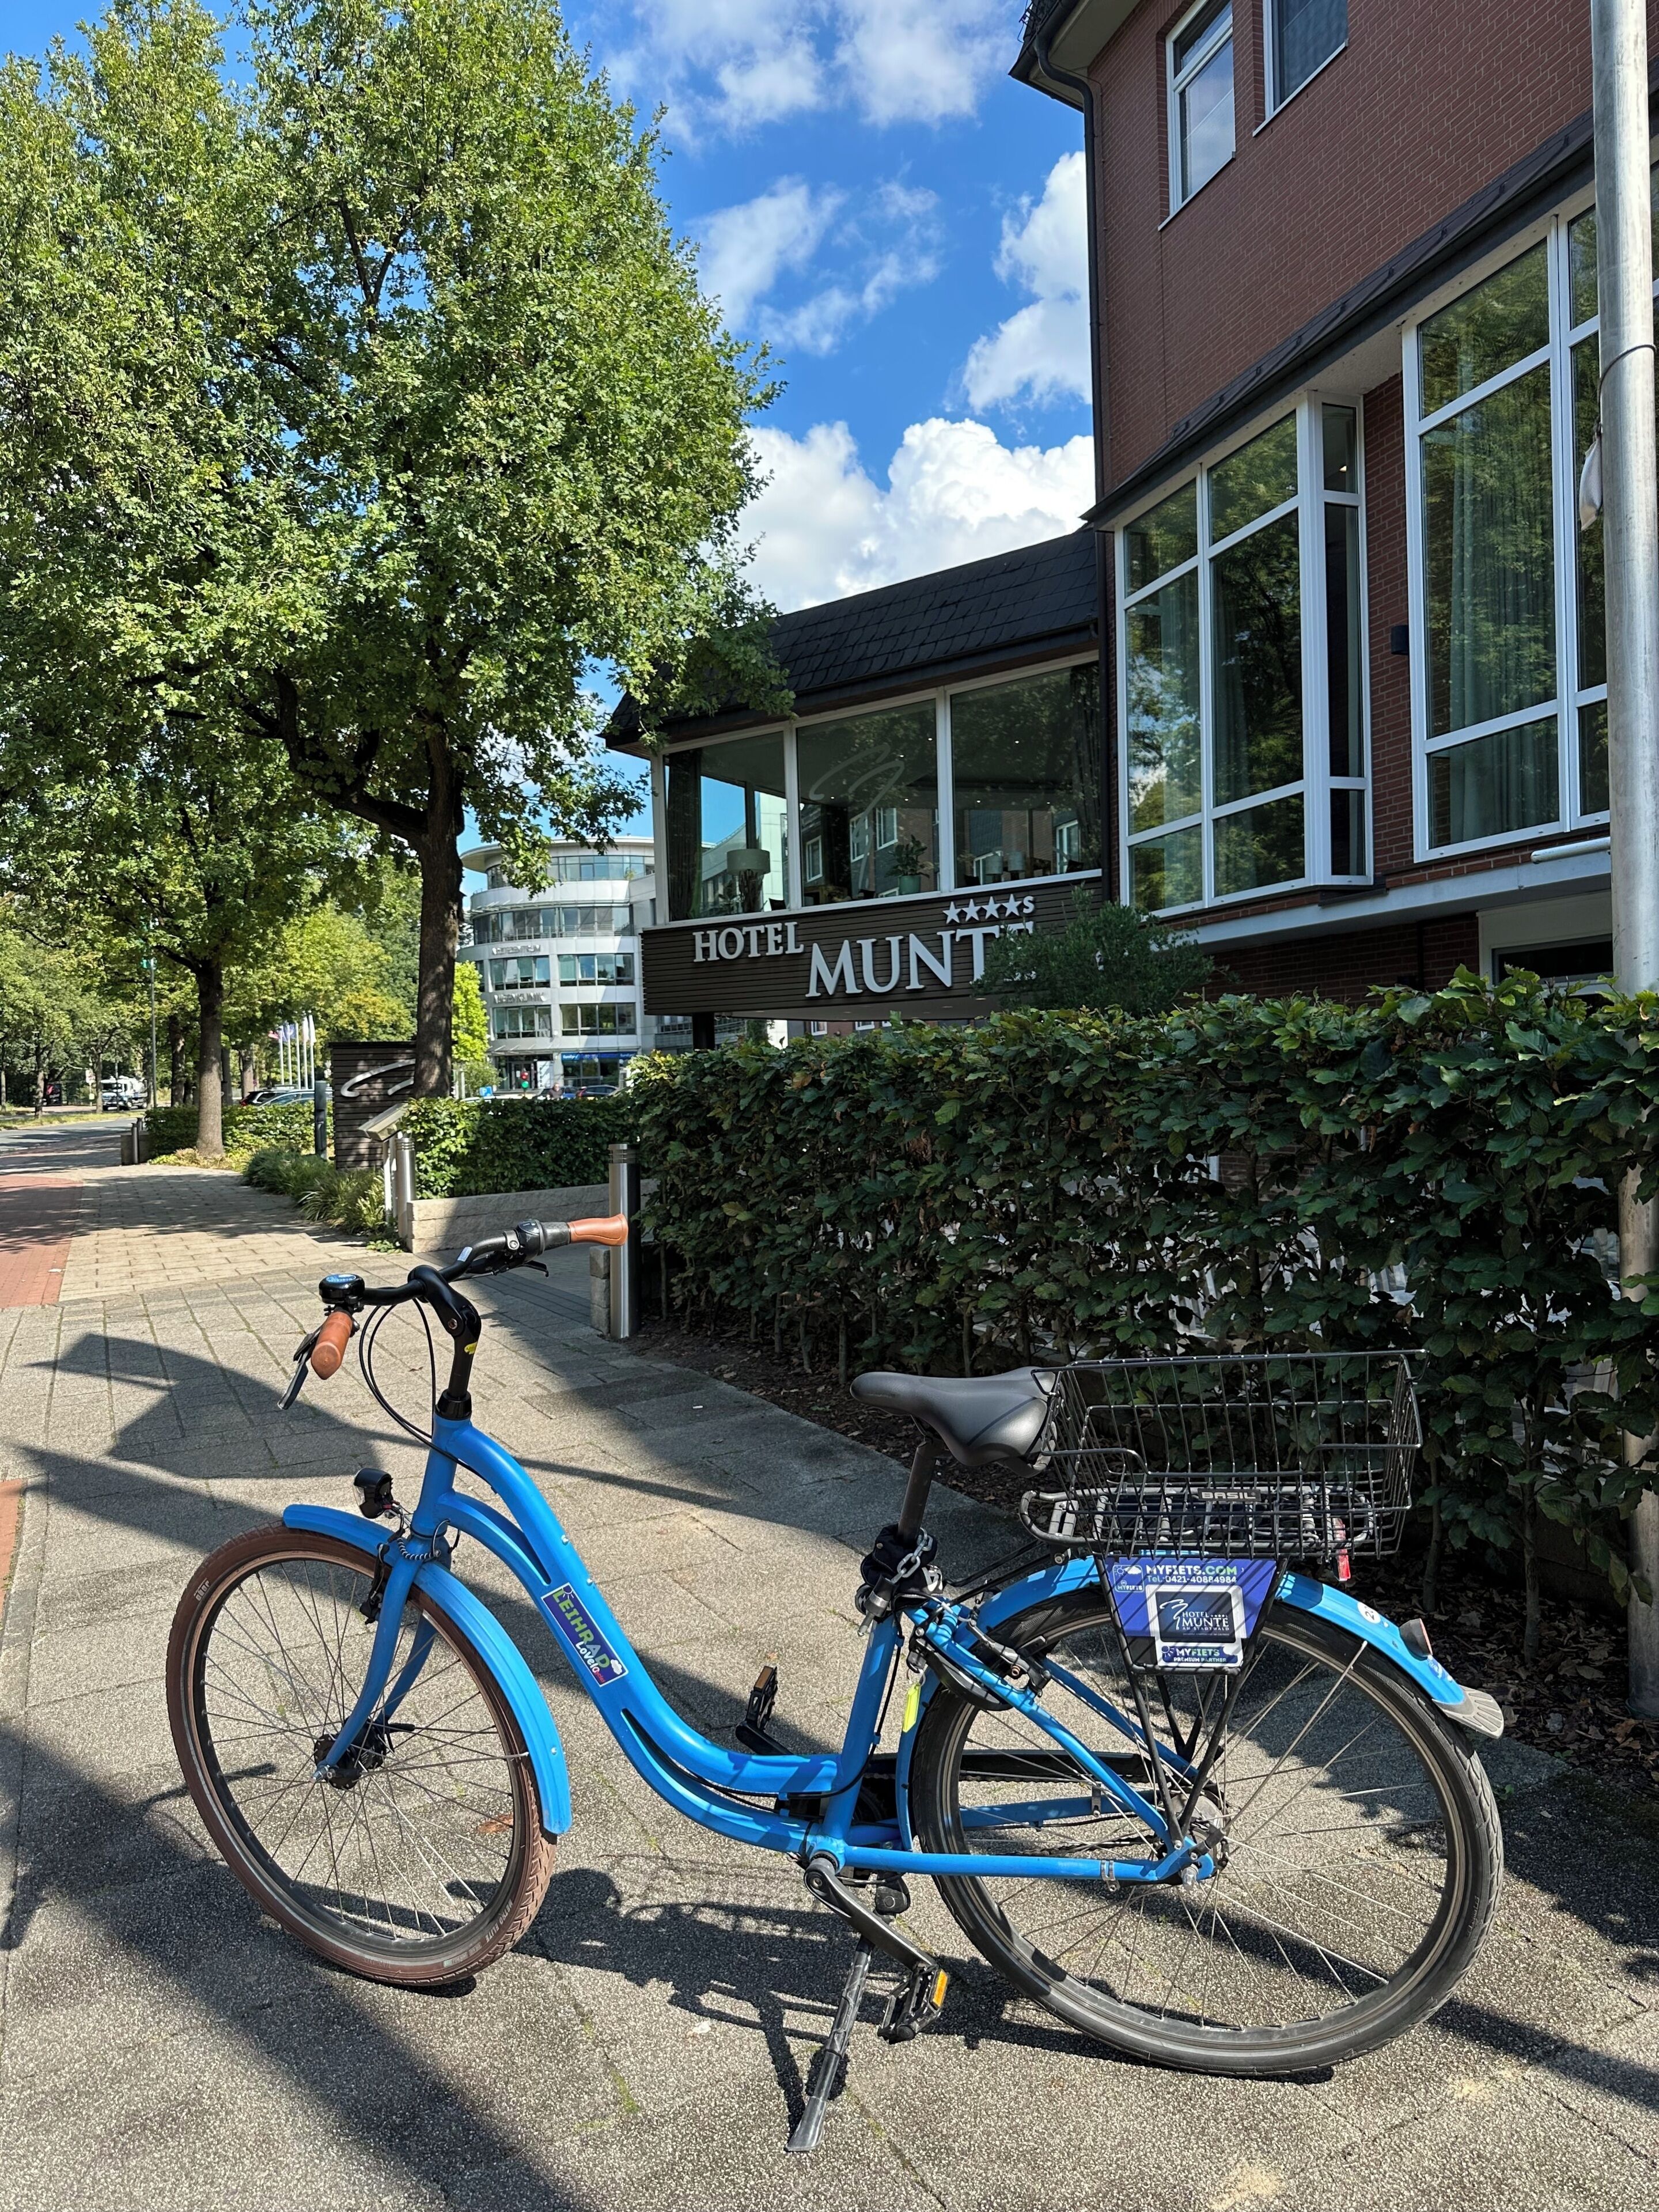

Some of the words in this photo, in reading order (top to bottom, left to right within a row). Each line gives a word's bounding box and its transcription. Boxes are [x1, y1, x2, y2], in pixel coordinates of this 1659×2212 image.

[692, 922, 804, 963] HOTEL
[805, 921, 1034, 997] MUNT
[1146, 1565, 1237, 1575] MYFIETS.COM
[552, 1589, 610, 1668] LEIHRAD
[1182, 1617, 1229, 1627] MUNTE
[1176, 1648, 1220, 1656] MYFIETS
[485, 1923, 500, 1943] ELITE
